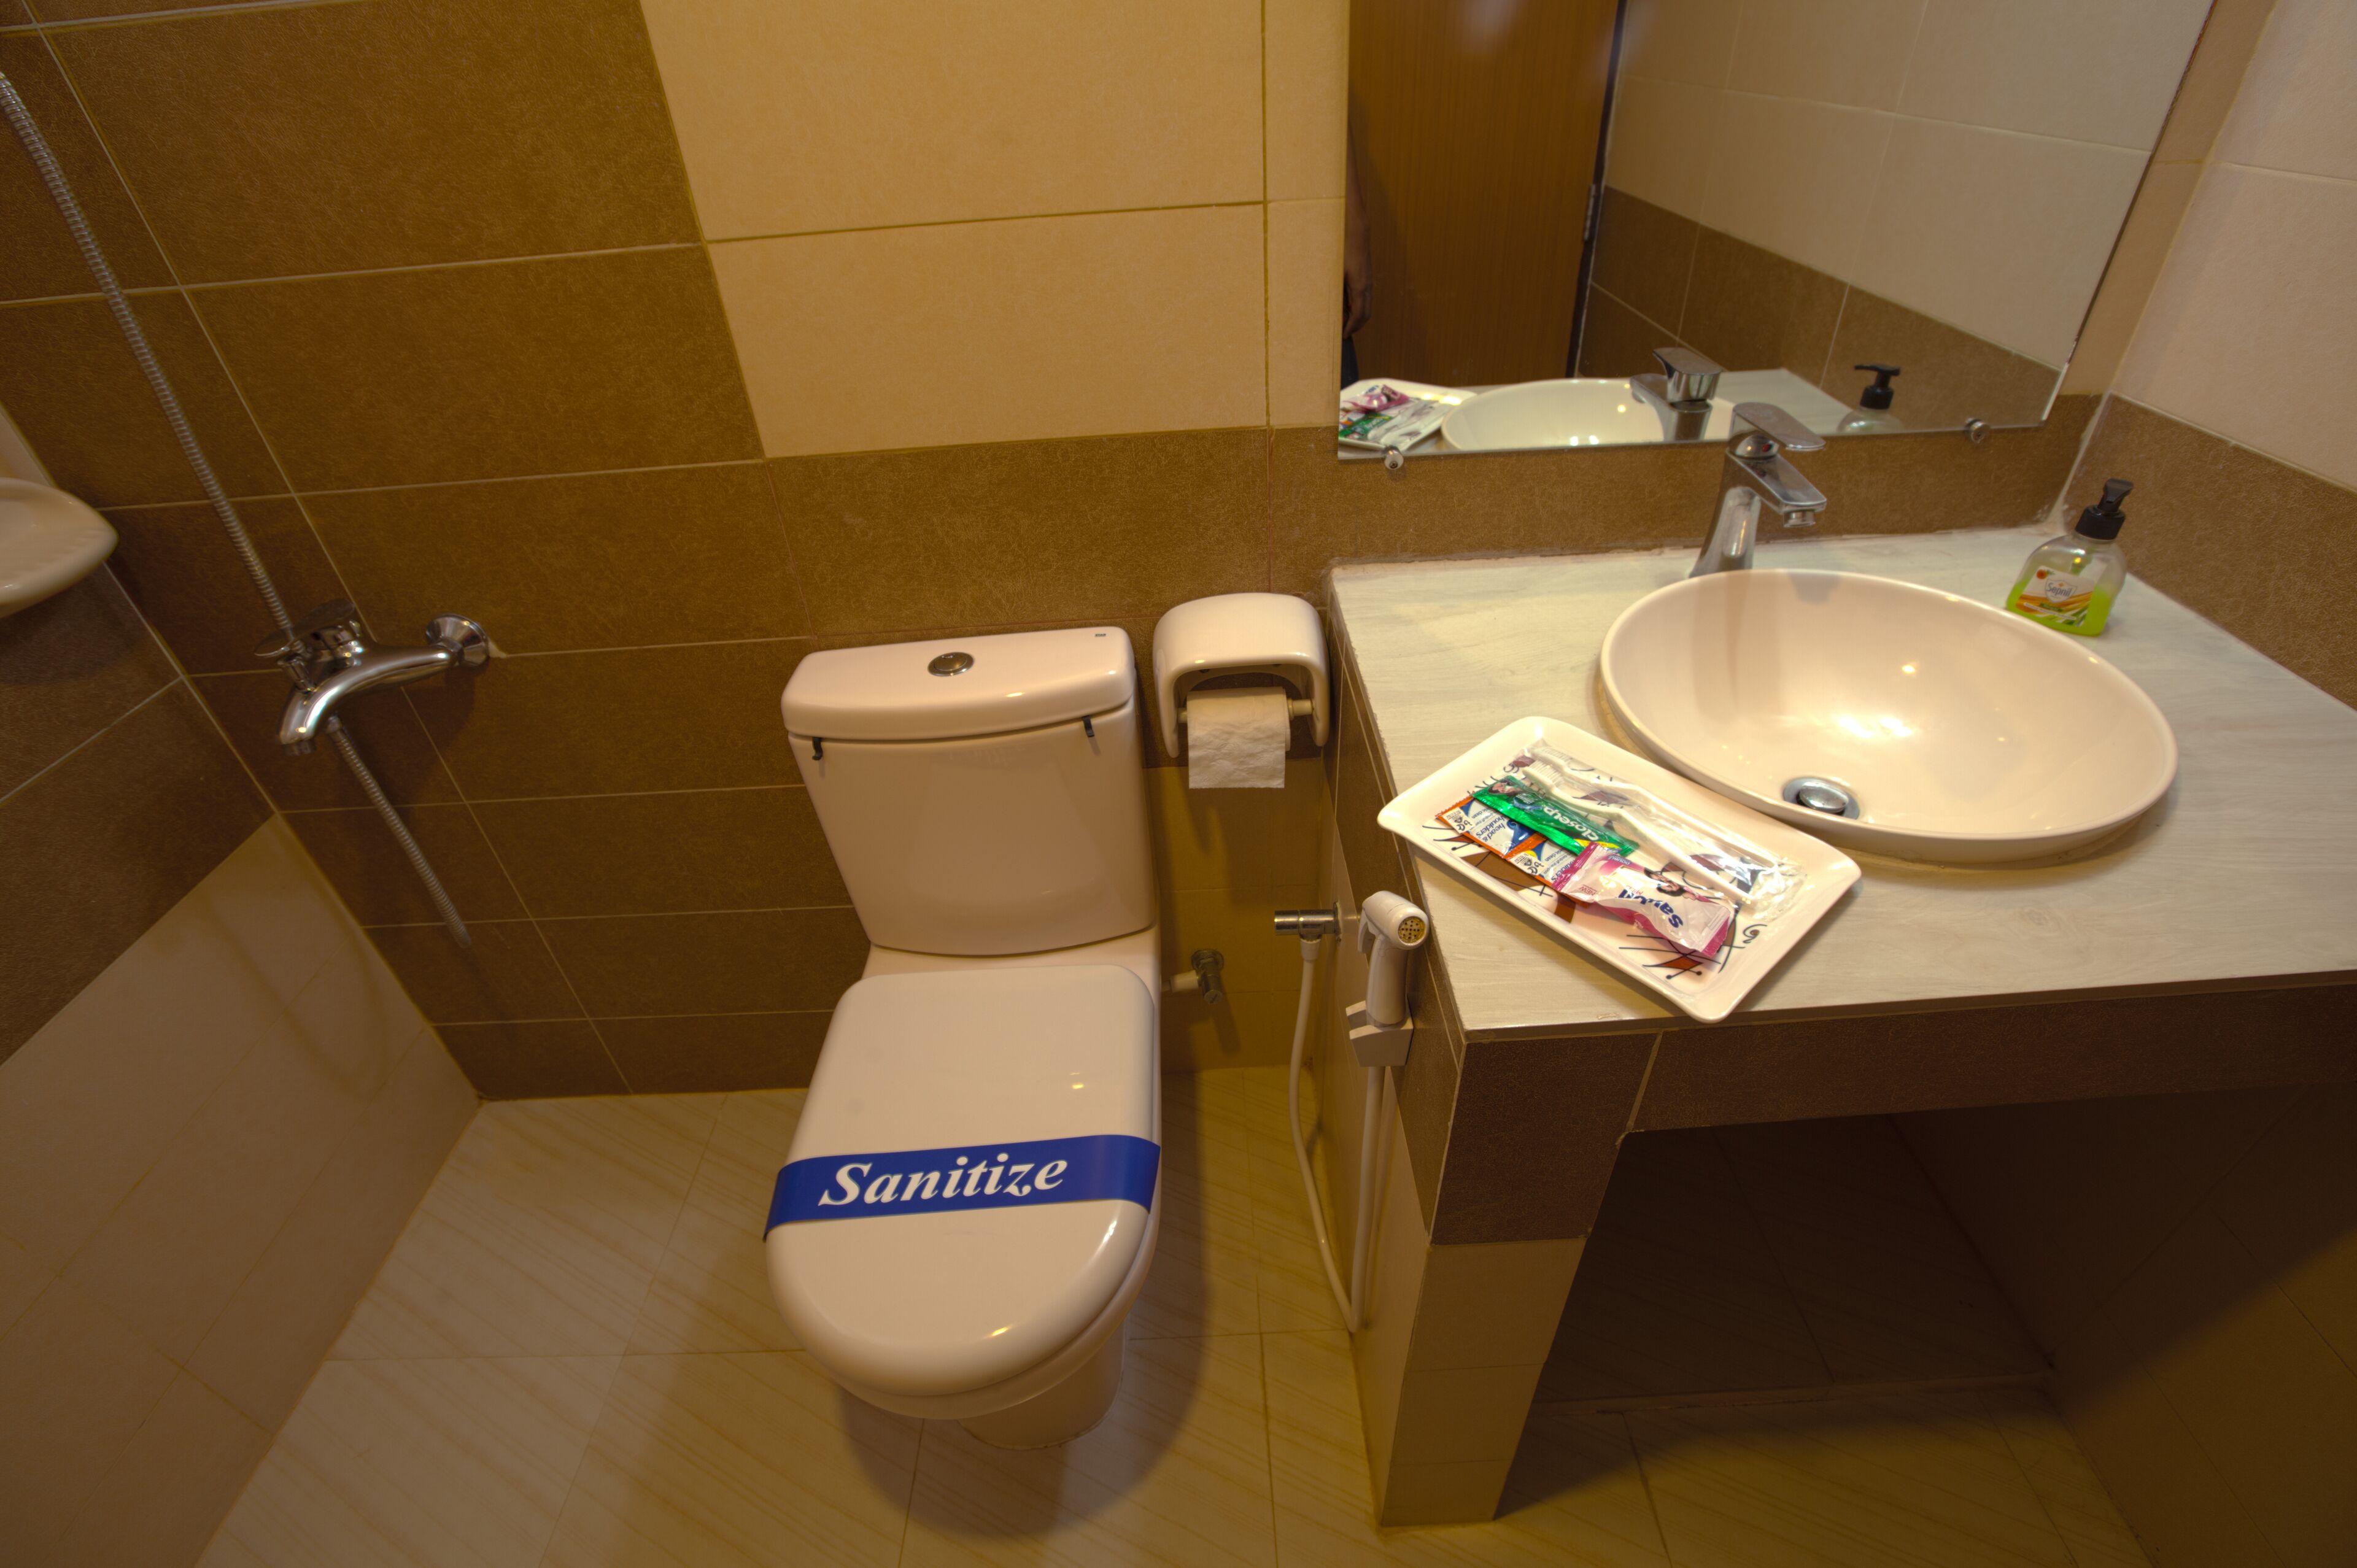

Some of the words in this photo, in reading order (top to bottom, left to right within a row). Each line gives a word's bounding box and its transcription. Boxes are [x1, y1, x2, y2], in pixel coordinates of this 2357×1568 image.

[2046, 582, 2073, 597] Sepnil
[1476, 815, 1506, 836] houlders
[1487, 822, 1506, 840] head
[1579, 886, 1596, 896] NEW
[818, 1153, 1067, 1206] Sanitize
